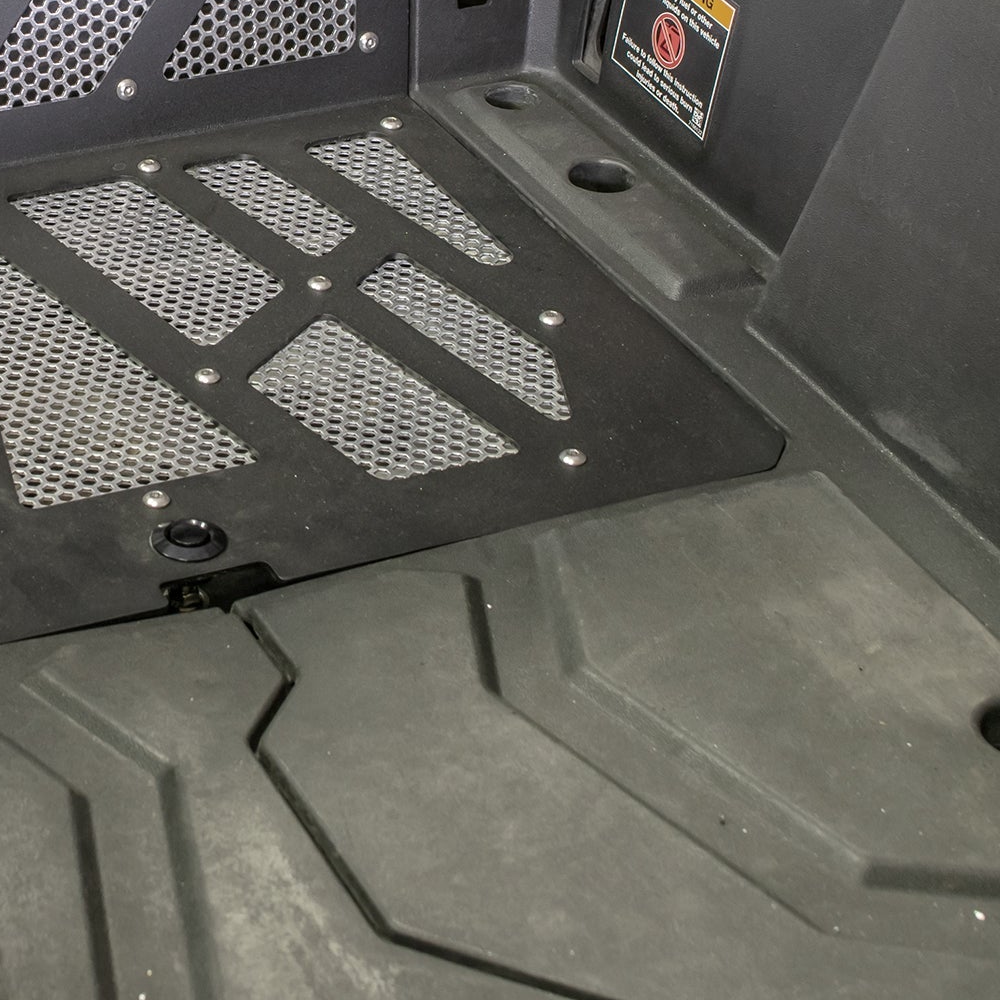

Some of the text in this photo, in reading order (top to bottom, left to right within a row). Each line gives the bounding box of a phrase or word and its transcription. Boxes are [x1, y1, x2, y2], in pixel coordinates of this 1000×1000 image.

[681, 13, 689, 23] on
[689, 18, 699, 32] this
[700, 29, 720, 49] vehicle
[690, 8, 697, 16] or
[697, 13, 713, 29] other
[622, 32, 640, 53] Failure
[640, 49, 646, 58] to
[647, 54, 663, 73] follow
[663, 69, 674, 83] this
[627, 51, 693, 113] could lead to serious burn
[656, 90, 662, 98] or
